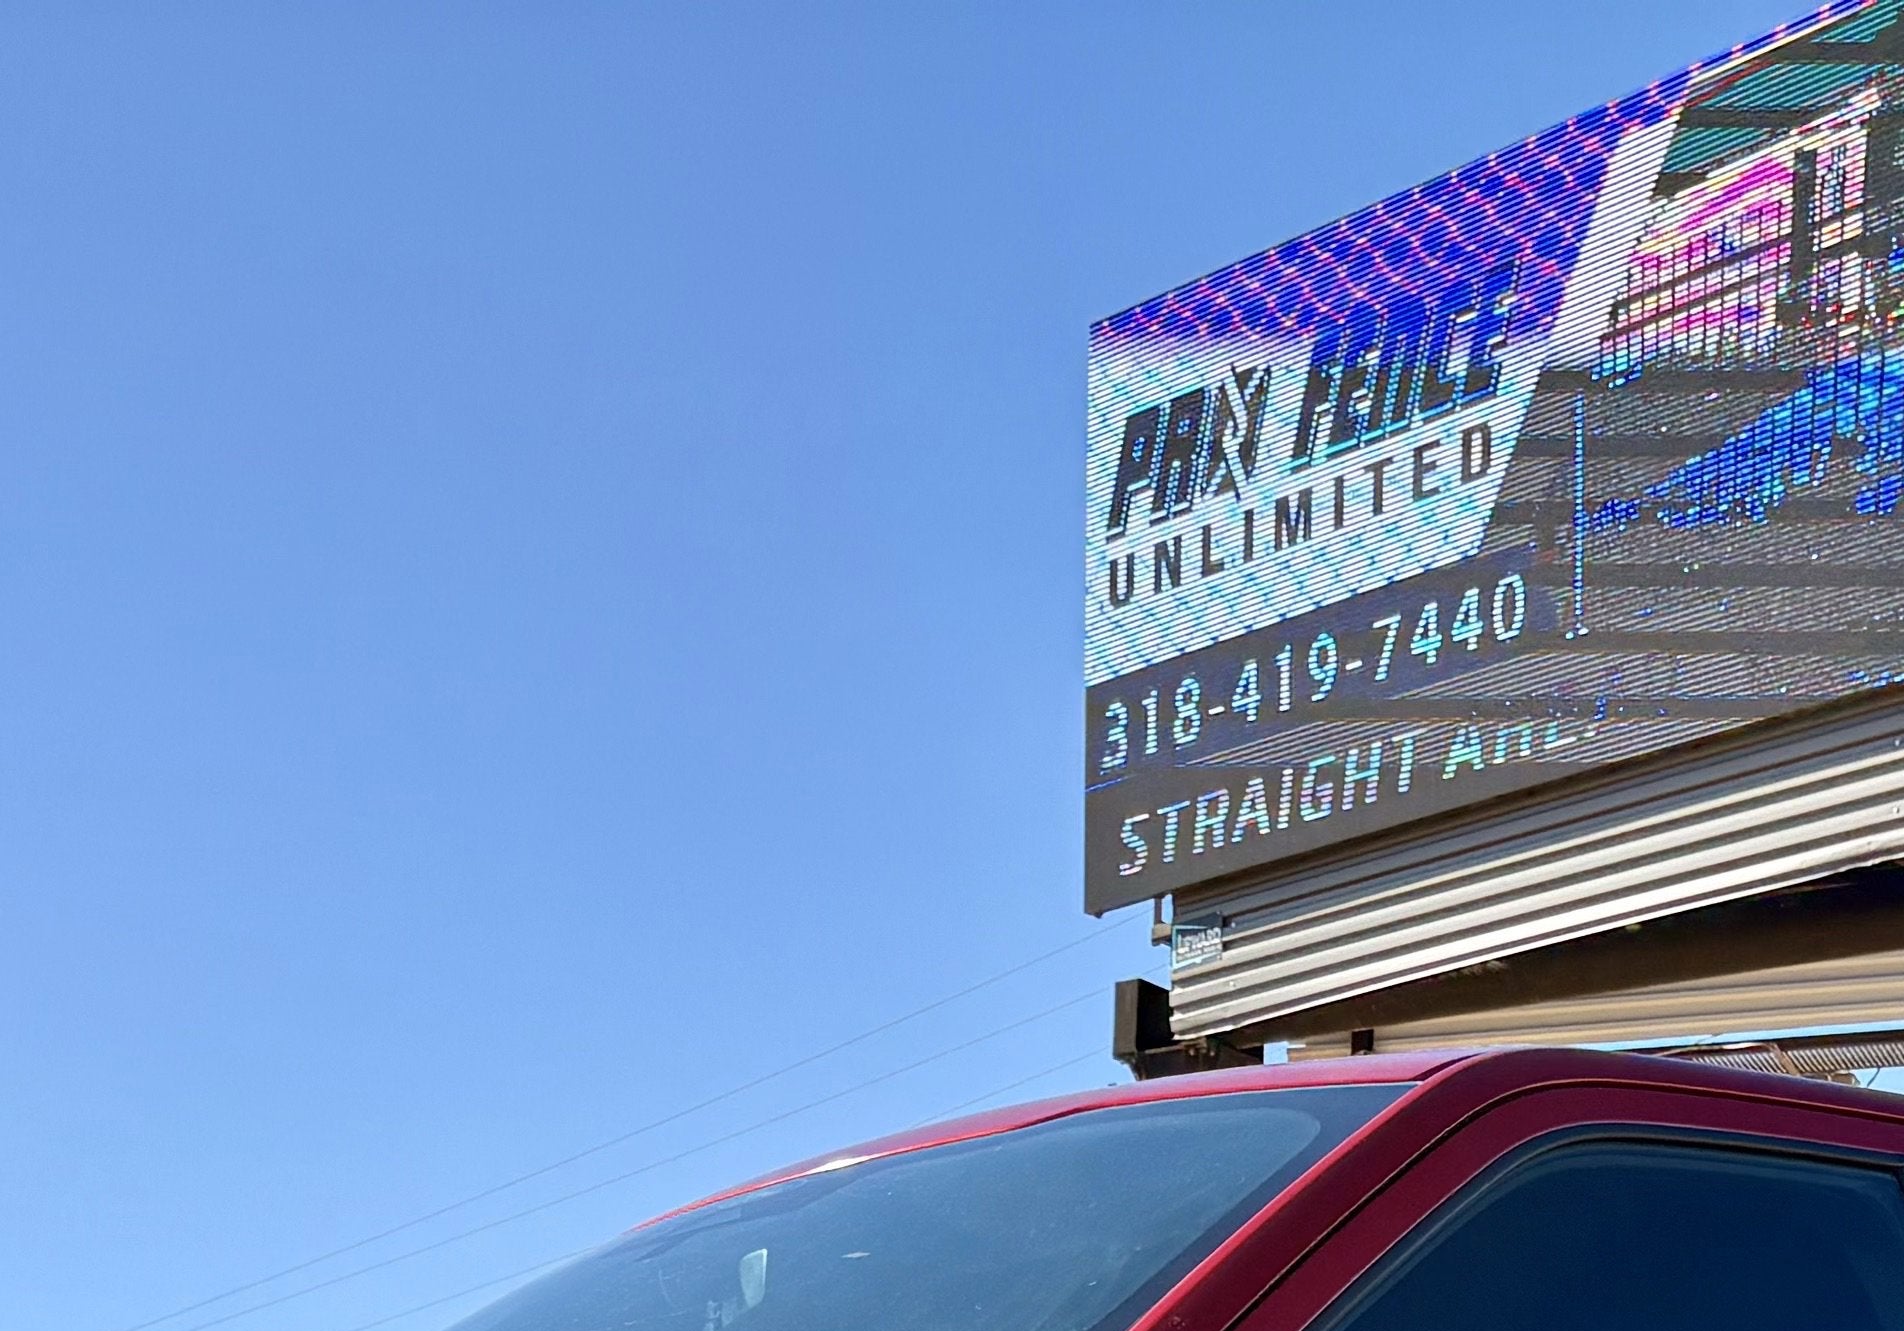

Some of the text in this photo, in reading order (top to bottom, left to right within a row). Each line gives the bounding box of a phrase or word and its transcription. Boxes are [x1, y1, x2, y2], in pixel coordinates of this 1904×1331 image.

[1108, 422, 1492, 608] UNLIMITED
[1100, 572, 1526, 776] 318-419-7440
[1118, 727, 1427, 877] STRAIGHT
